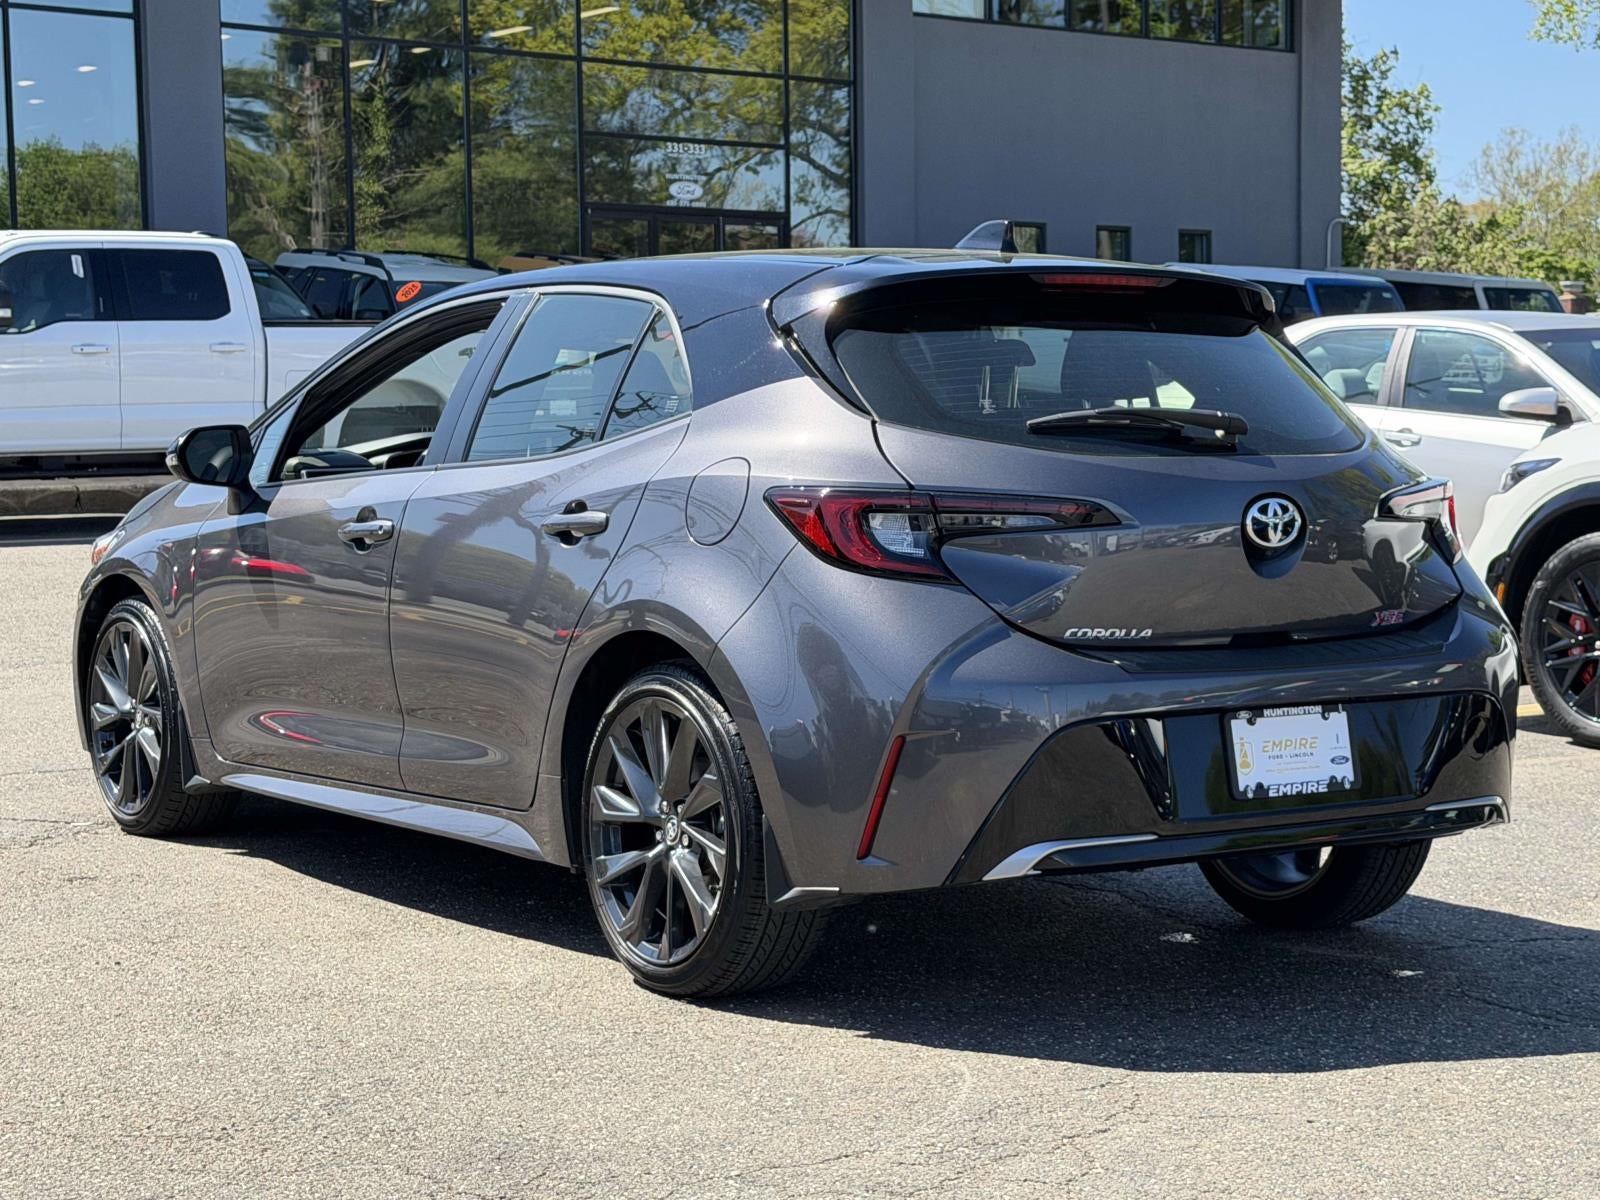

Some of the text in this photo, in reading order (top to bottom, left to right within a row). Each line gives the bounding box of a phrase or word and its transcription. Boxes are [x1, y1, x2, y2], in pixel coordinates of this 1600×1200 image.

[1063, 627, 1153, 640] COROLLA
[1263, 705, 1321, 717] HUNTINGTON
[1262, 736, 1319, 753] EMPIRE
[1268, 781, 1328, 797] EMPIRE
